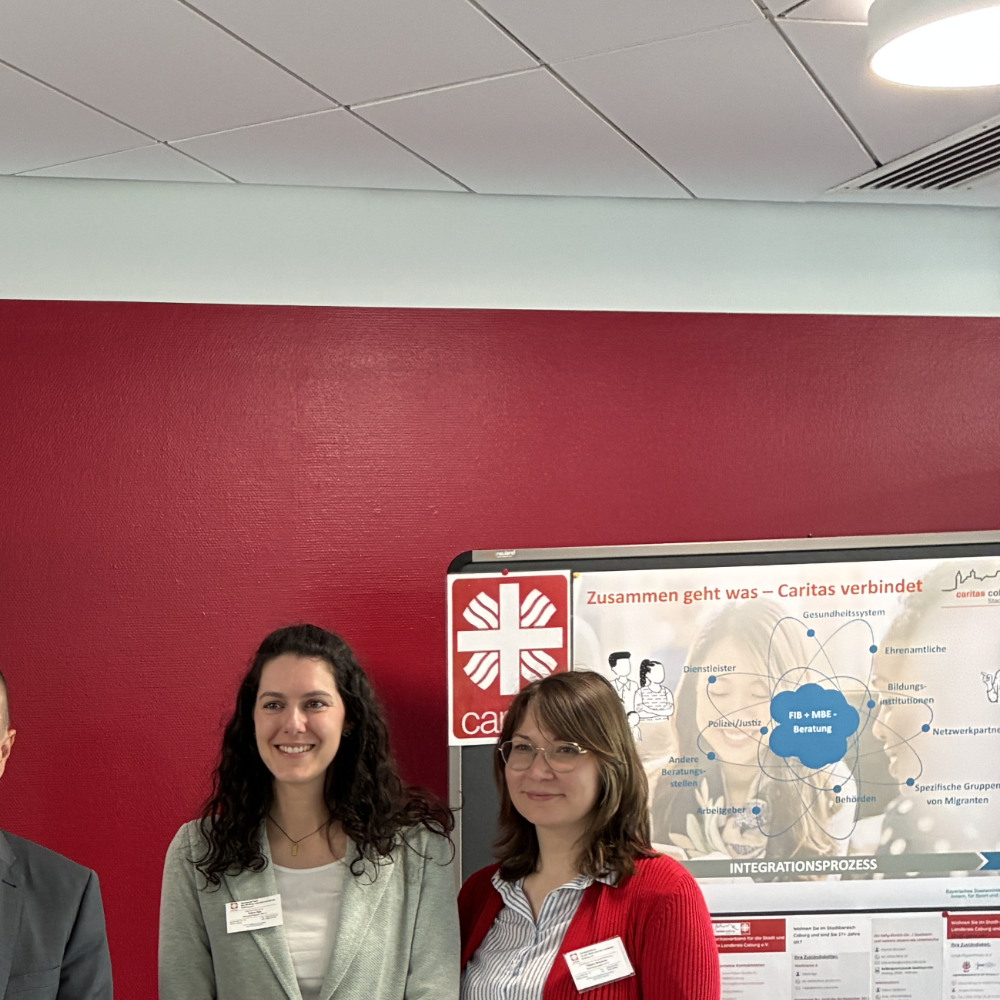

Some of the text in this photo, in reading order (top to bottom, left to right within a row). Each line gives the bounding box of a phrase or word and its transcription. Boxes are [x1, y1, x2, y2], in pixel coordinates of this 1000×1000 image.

[586, 589, 678, 605] Zusammen
[683, 586, 722, 606] geht
[725, 587, 758, 600] was
[778, 582, 836, 598] Caritas
[841, 578, 923, 596] verbindet
[956, 590, 985, 598] caritas
[803, 608, 886, 619] Gesundheitssystem
[885, 645, 947, 655] Ehrenamtliche
[683, 664, 736, 673] Dienstleister
[888, 682, 927, 692] Bildungs-
[880, 696, 935, 705] institutionen
[789, 711, 802, 720] FIB
[811, 710, 832, 719] MBE
[708, 718, 762, 729] Polizei/Justiz
[793, 724, 832, 735] Beratung
[932, 726, 1000, 737] Netzwerkpartne
[668, 755, 699, 764] Andere
[661, 767, 706, 778] Beratungs-
[670, 779, 698, 788] stellen
[915, 782, 966, 794] Spezifische
[835, 793, 877, 804] Behörden
[927, 796, 989, 807] von Migranten
[697, 806, 746, 816] Arbeitgeber
[730, 858, 878, 875] INTEGRATIONSPROZESS
